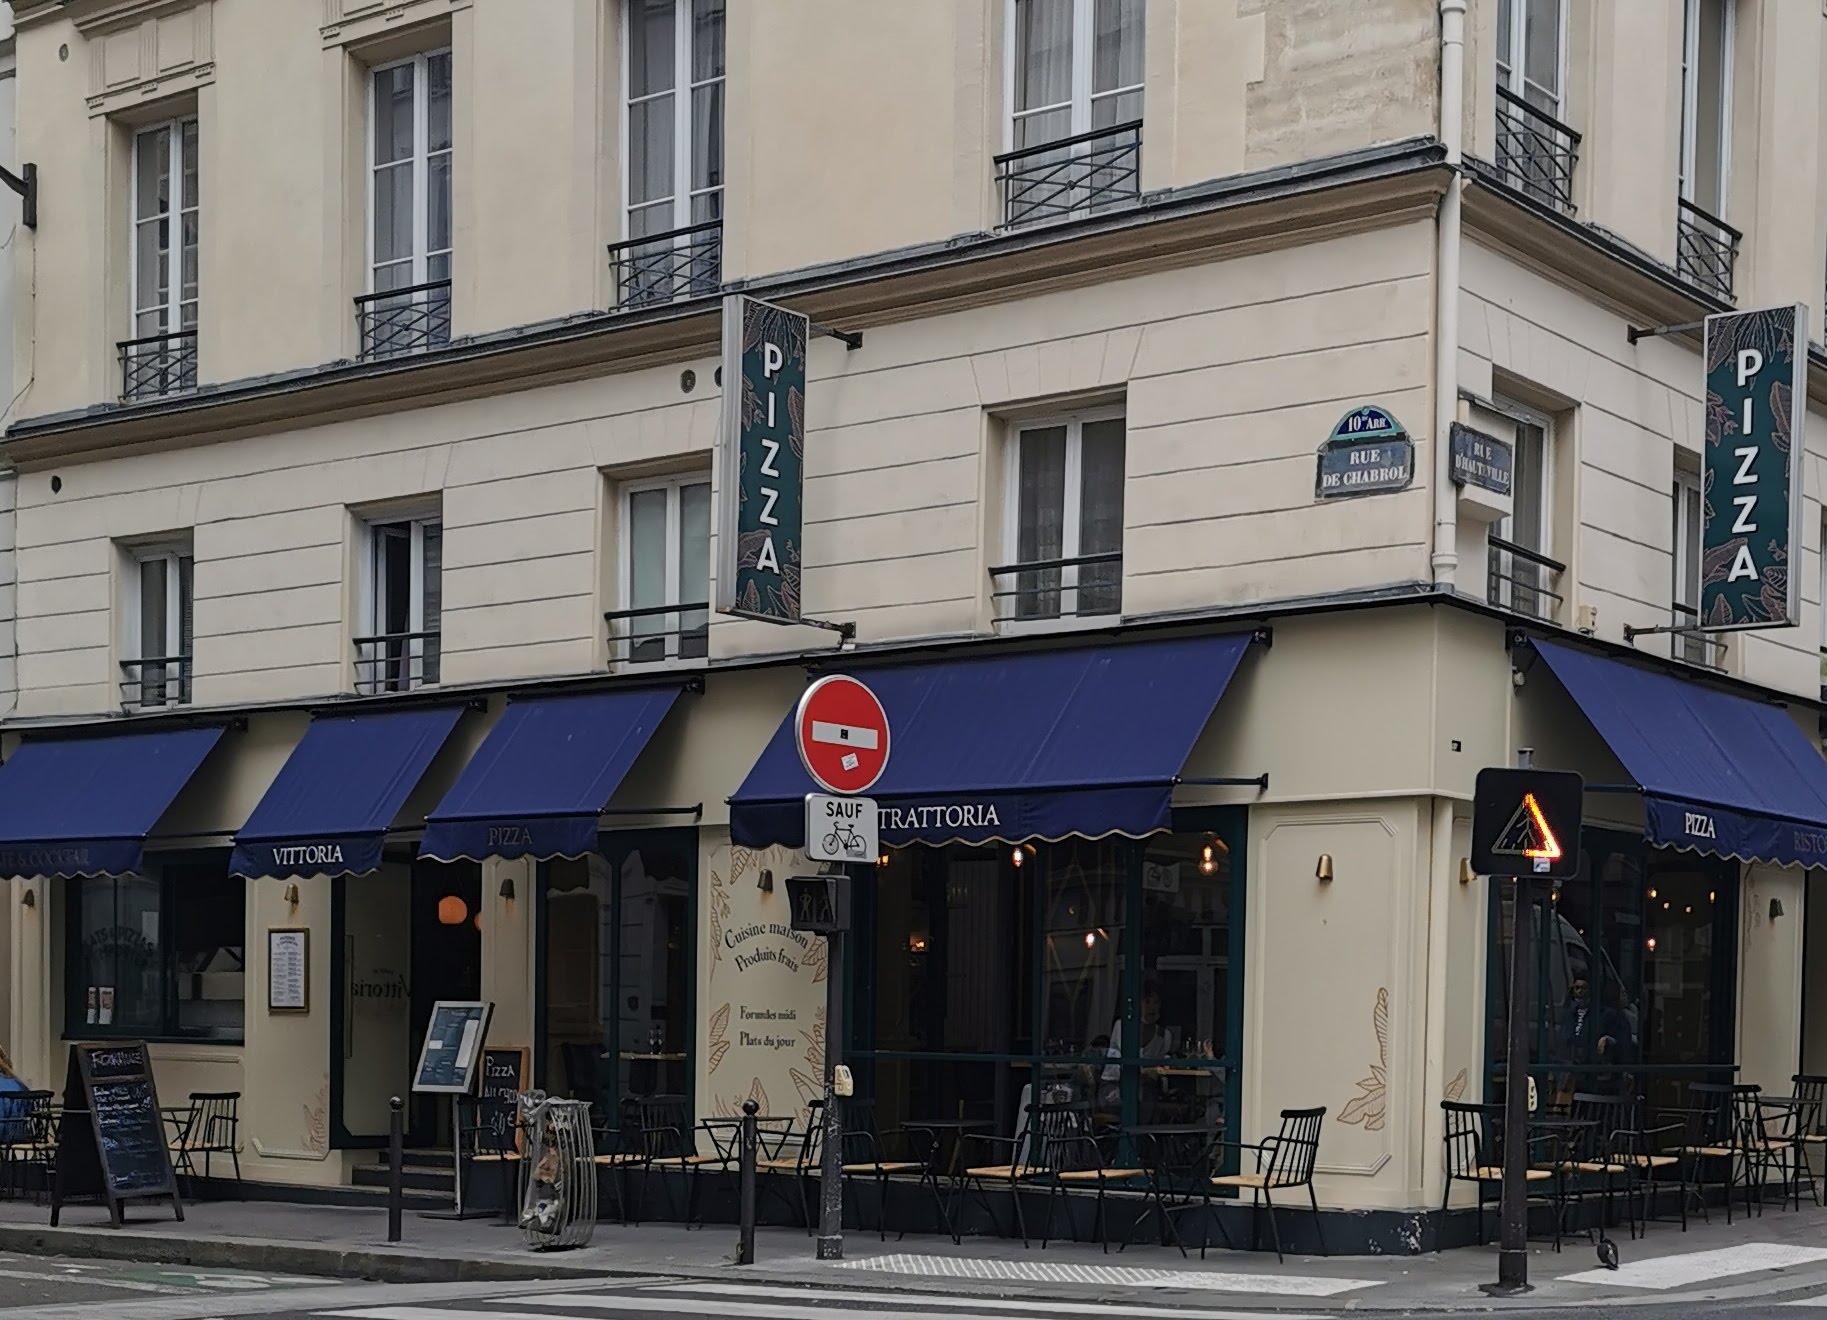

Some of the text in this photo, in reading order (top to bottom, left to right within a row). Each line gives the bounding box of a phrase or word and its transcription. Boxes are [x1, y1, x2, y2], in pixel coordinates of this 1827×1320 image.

[756, 341, 783, 574] PIZZA
[1349, 449, 1381, 465] RUE
[1727, 348, 1764, 583] PIZZA
[1322, 465, 1408, 488] DE CHABROL
[826, 801, 863, 819] SAUF
[878, 804, 1001, 830] TRATTORIA
[488, 827, 533, 847] PIZZA
[1684, 812, 1716, 839] PIZZA
[272, 844, 344, 866] VITTORIA
[724, 922, 810, 950] Cuisine maison
[734, 946, 800, 973] Produits frais
[740, 1005, 797, 1020] Formules midi
[740, 1031, 796, 1051] Plats du jour
